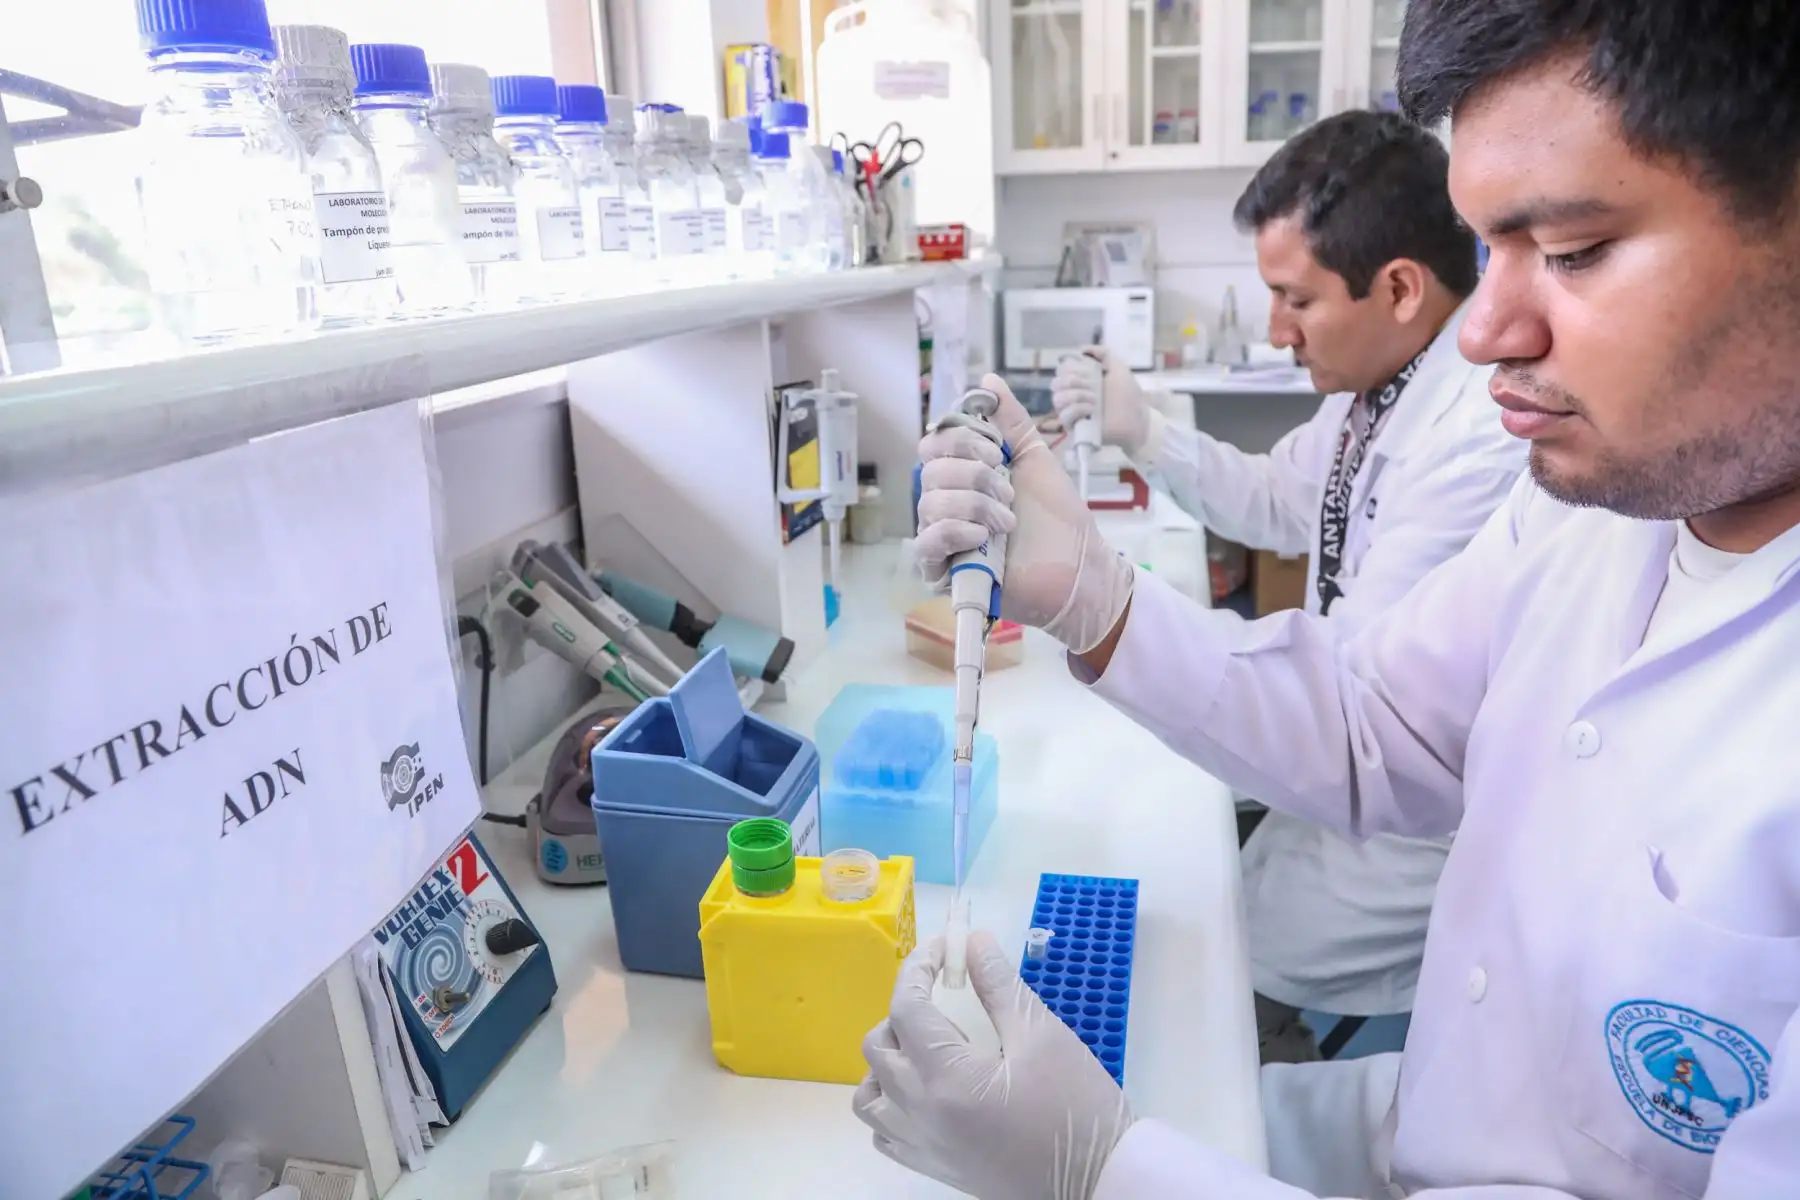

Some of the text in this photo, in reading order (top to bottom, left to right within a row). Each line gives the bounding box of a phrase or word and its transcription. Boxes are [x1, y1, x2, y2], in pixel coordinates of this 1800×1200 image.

[321, 227, 364, 239] Tampón
[366, 225, 375, 234] de
[6, 602, 392, 837] EXTRACCIÓN DE
[220, 748, 307, 839] ADN
[408, 773, 444, 818] IPEN
[400, 884, 465, 951] GENIE
[1610, 1006, 1770, 1101] FACULTAD DE CIENCIAS
[1614, 1055, 1656, 1120] ESCUELA
[1661, 1118, 1683, 1135] DE
